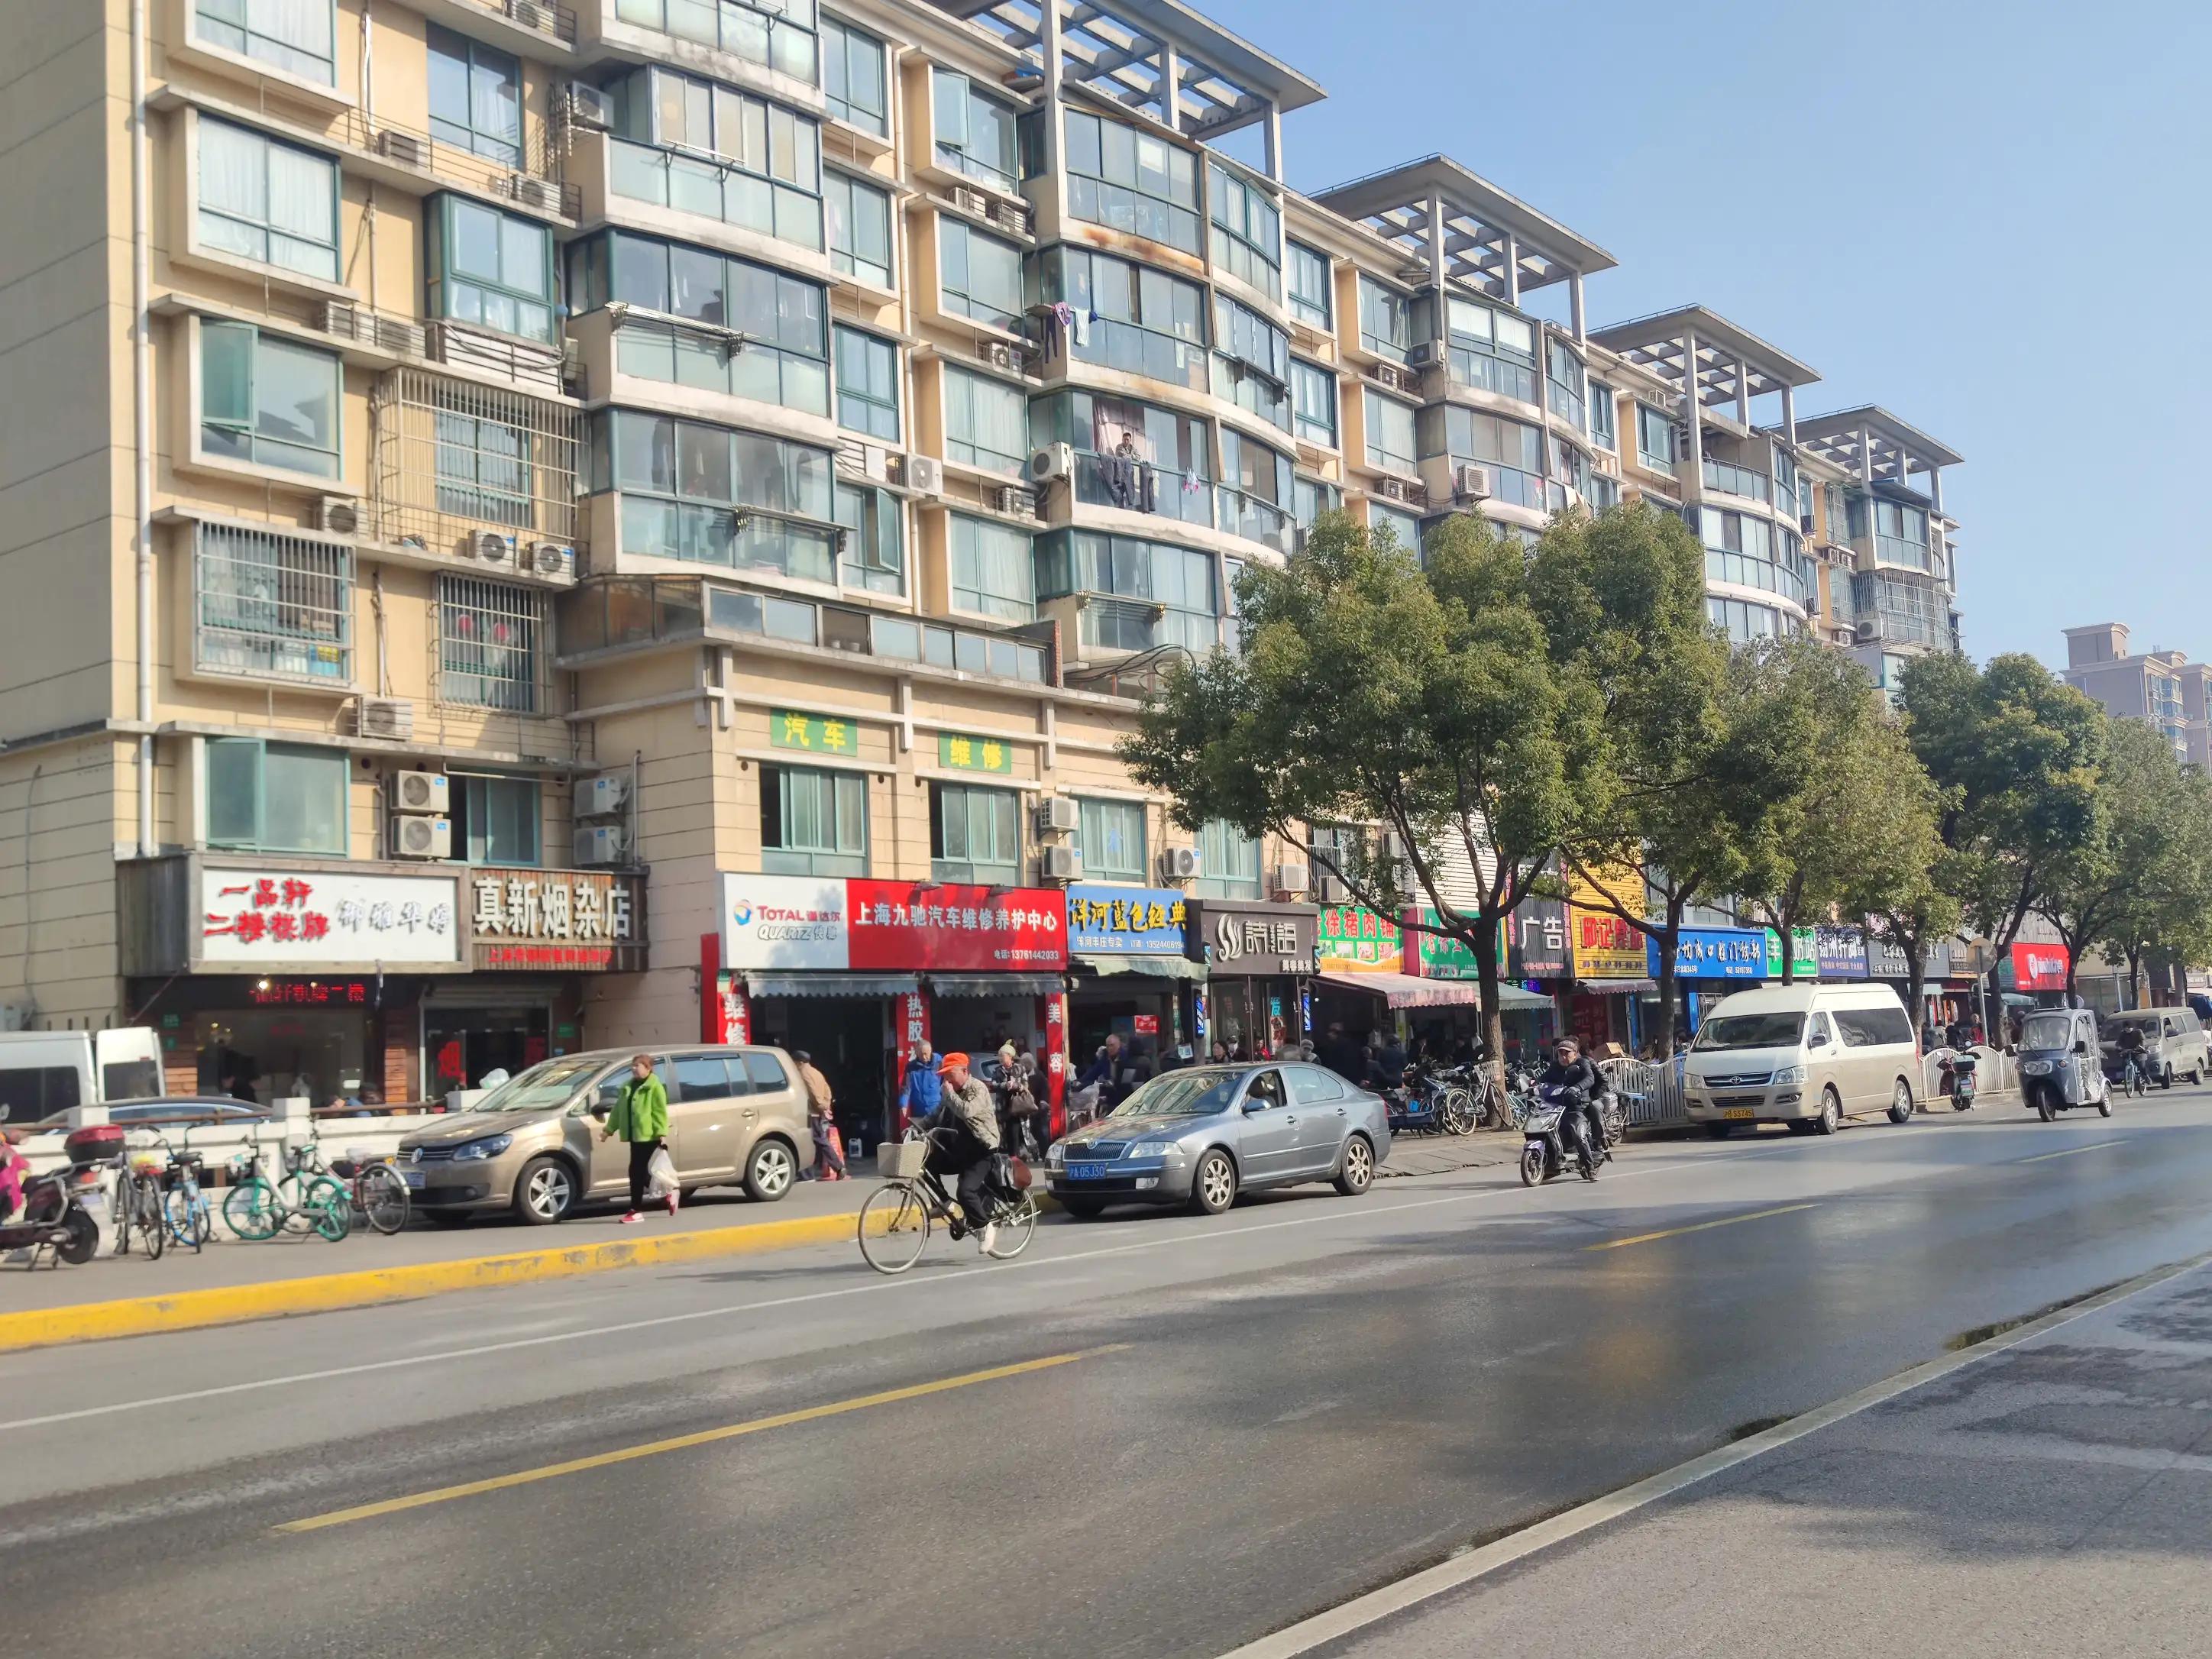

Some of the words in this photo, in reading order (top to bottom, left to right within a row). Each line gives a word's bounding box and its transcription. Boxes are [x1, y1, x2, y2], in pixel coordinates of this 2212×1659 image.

[784, 711, 846, 752] 汽车
[950, 734, 1001, 770] 维修
[219, 878, 313, 910] 一品轩
[474, 878, 630, 938] 真新烟杂店
[756, 906, 804, 922] TOTAL
[855, 901, 1057, 931] 上海九驰汽车维修养护中心
[1069, 897, 1187, 933] 洋河蓝色经典
[1317, 909, 1395, 939] 徐猪肉铺
[758, 924, 812, 940] QUARTZ
[1521, 917, 1564, 949] 广告
[1282, 959, 1311, 972] 美容美发
[724, 993, 746, 1044] 维修
[1047, 1002, 1063, 1073] 美容
